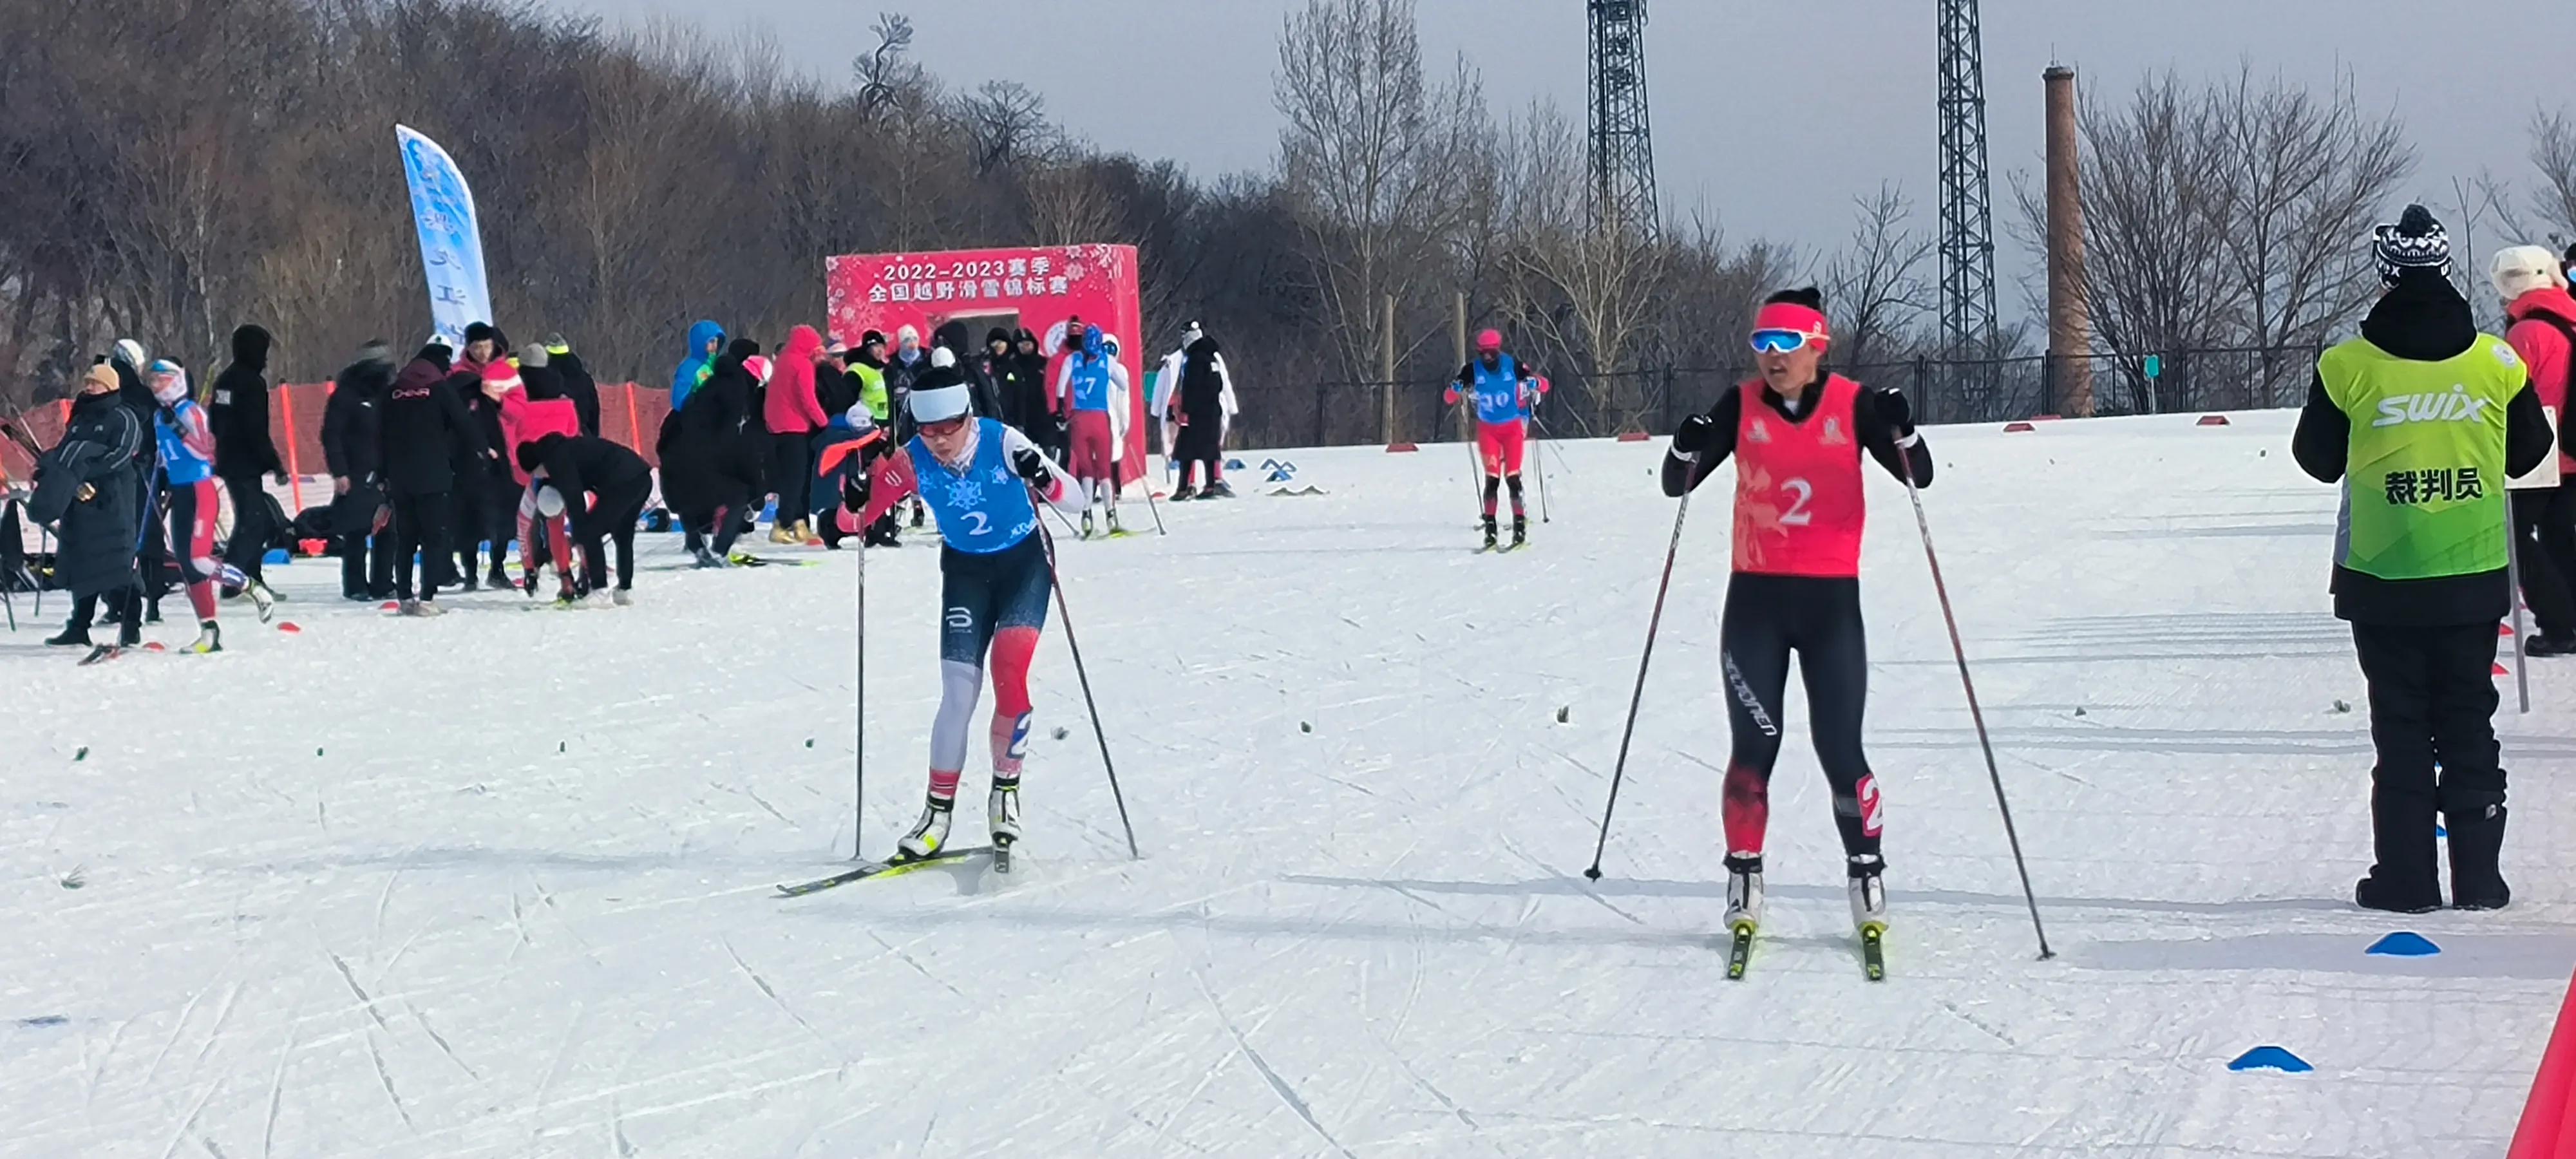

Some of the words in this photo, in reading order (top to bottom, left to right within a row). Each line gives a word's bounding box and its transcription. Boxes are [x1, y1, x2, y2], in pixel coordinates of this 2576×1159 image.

[883, 256, 1050, 281] 2022-2023赛季
[868, 274, 1068, 303] 全国越野滑雪锦标赛
[1085, 377, 1097, 395] 7
[1779, 478, 1813, 526] 2
[2385, 467, 2483, 505] 裁判员
[960, 511, 993, 536] 2
[1011, 713, 1032, 755] 2
[1862, 778, 1883, 831] 2
